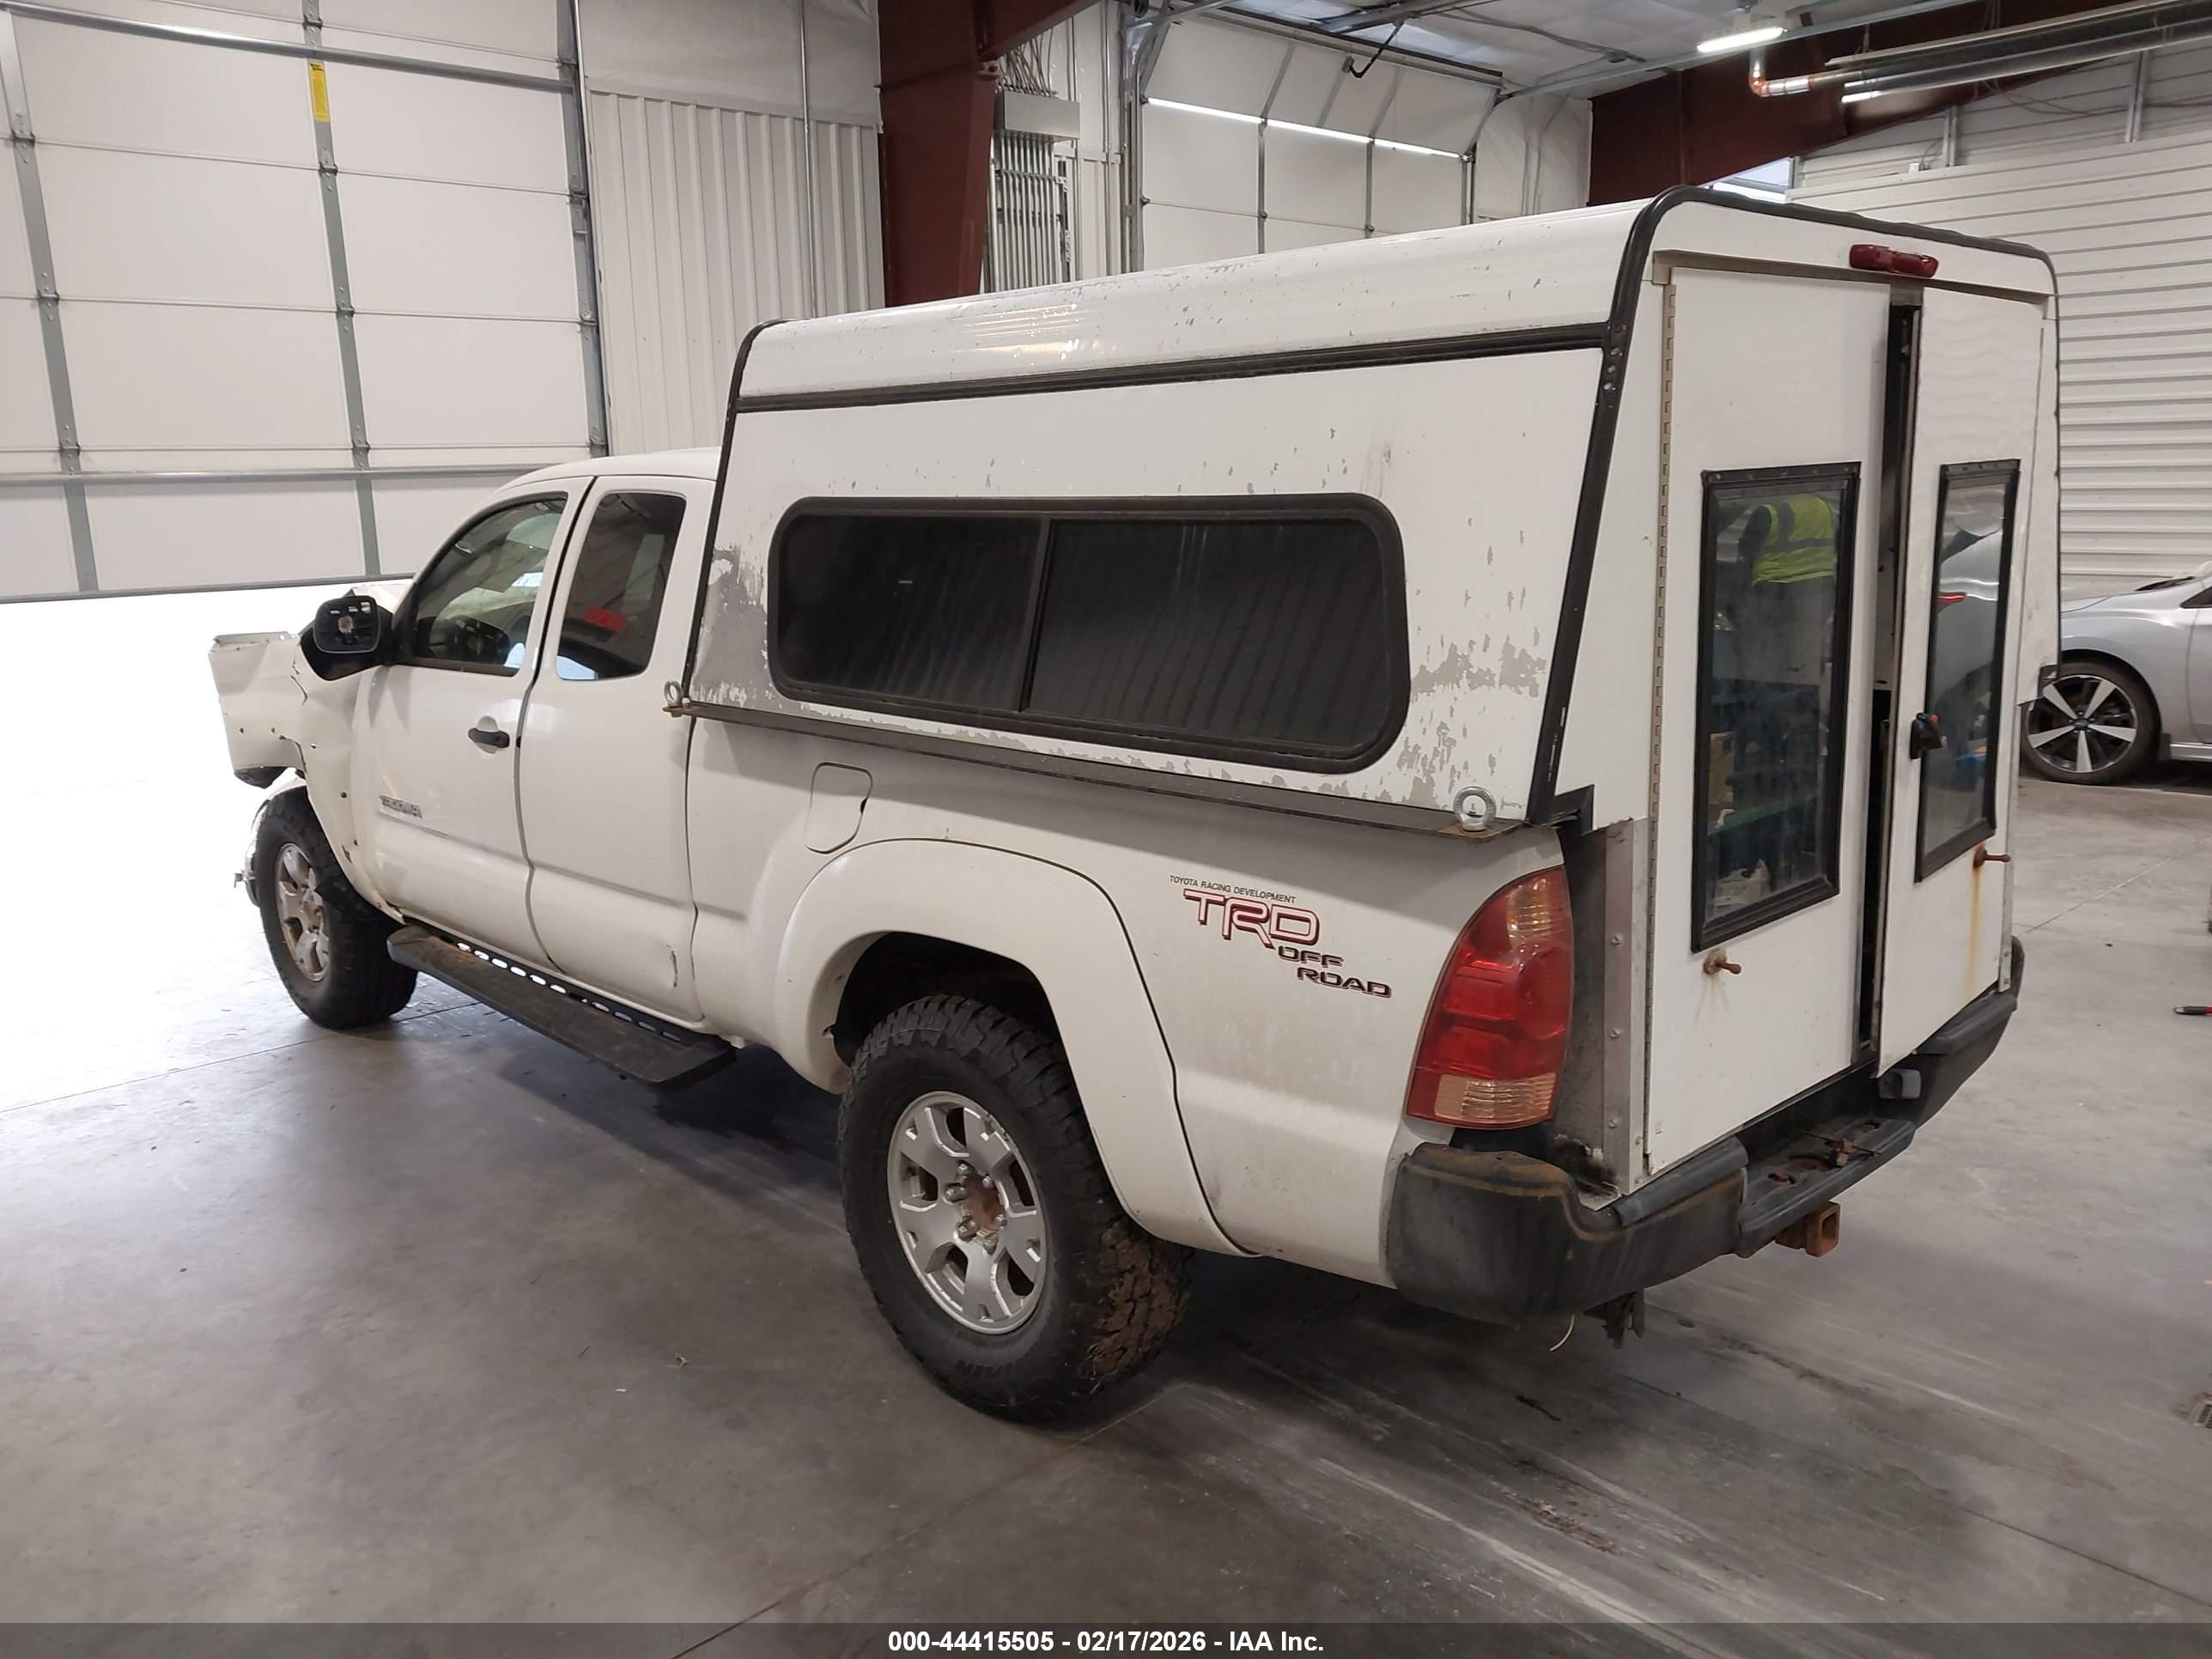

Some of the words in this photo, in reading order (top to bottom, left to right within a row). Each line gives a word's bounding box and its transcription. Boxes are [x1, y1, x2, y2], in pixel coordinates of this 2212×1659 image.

[1170, 875, 1198, 887] TOYOTA
[1200, 880, 1231, 893] RACING
[1233, 886, 1297, 904] DEVELOPMENT
[1183, 888, 1319, 949] TRD
[1278, 945, 1344, 968] OFF
[1297, 967, 1391, 998] ROAD
